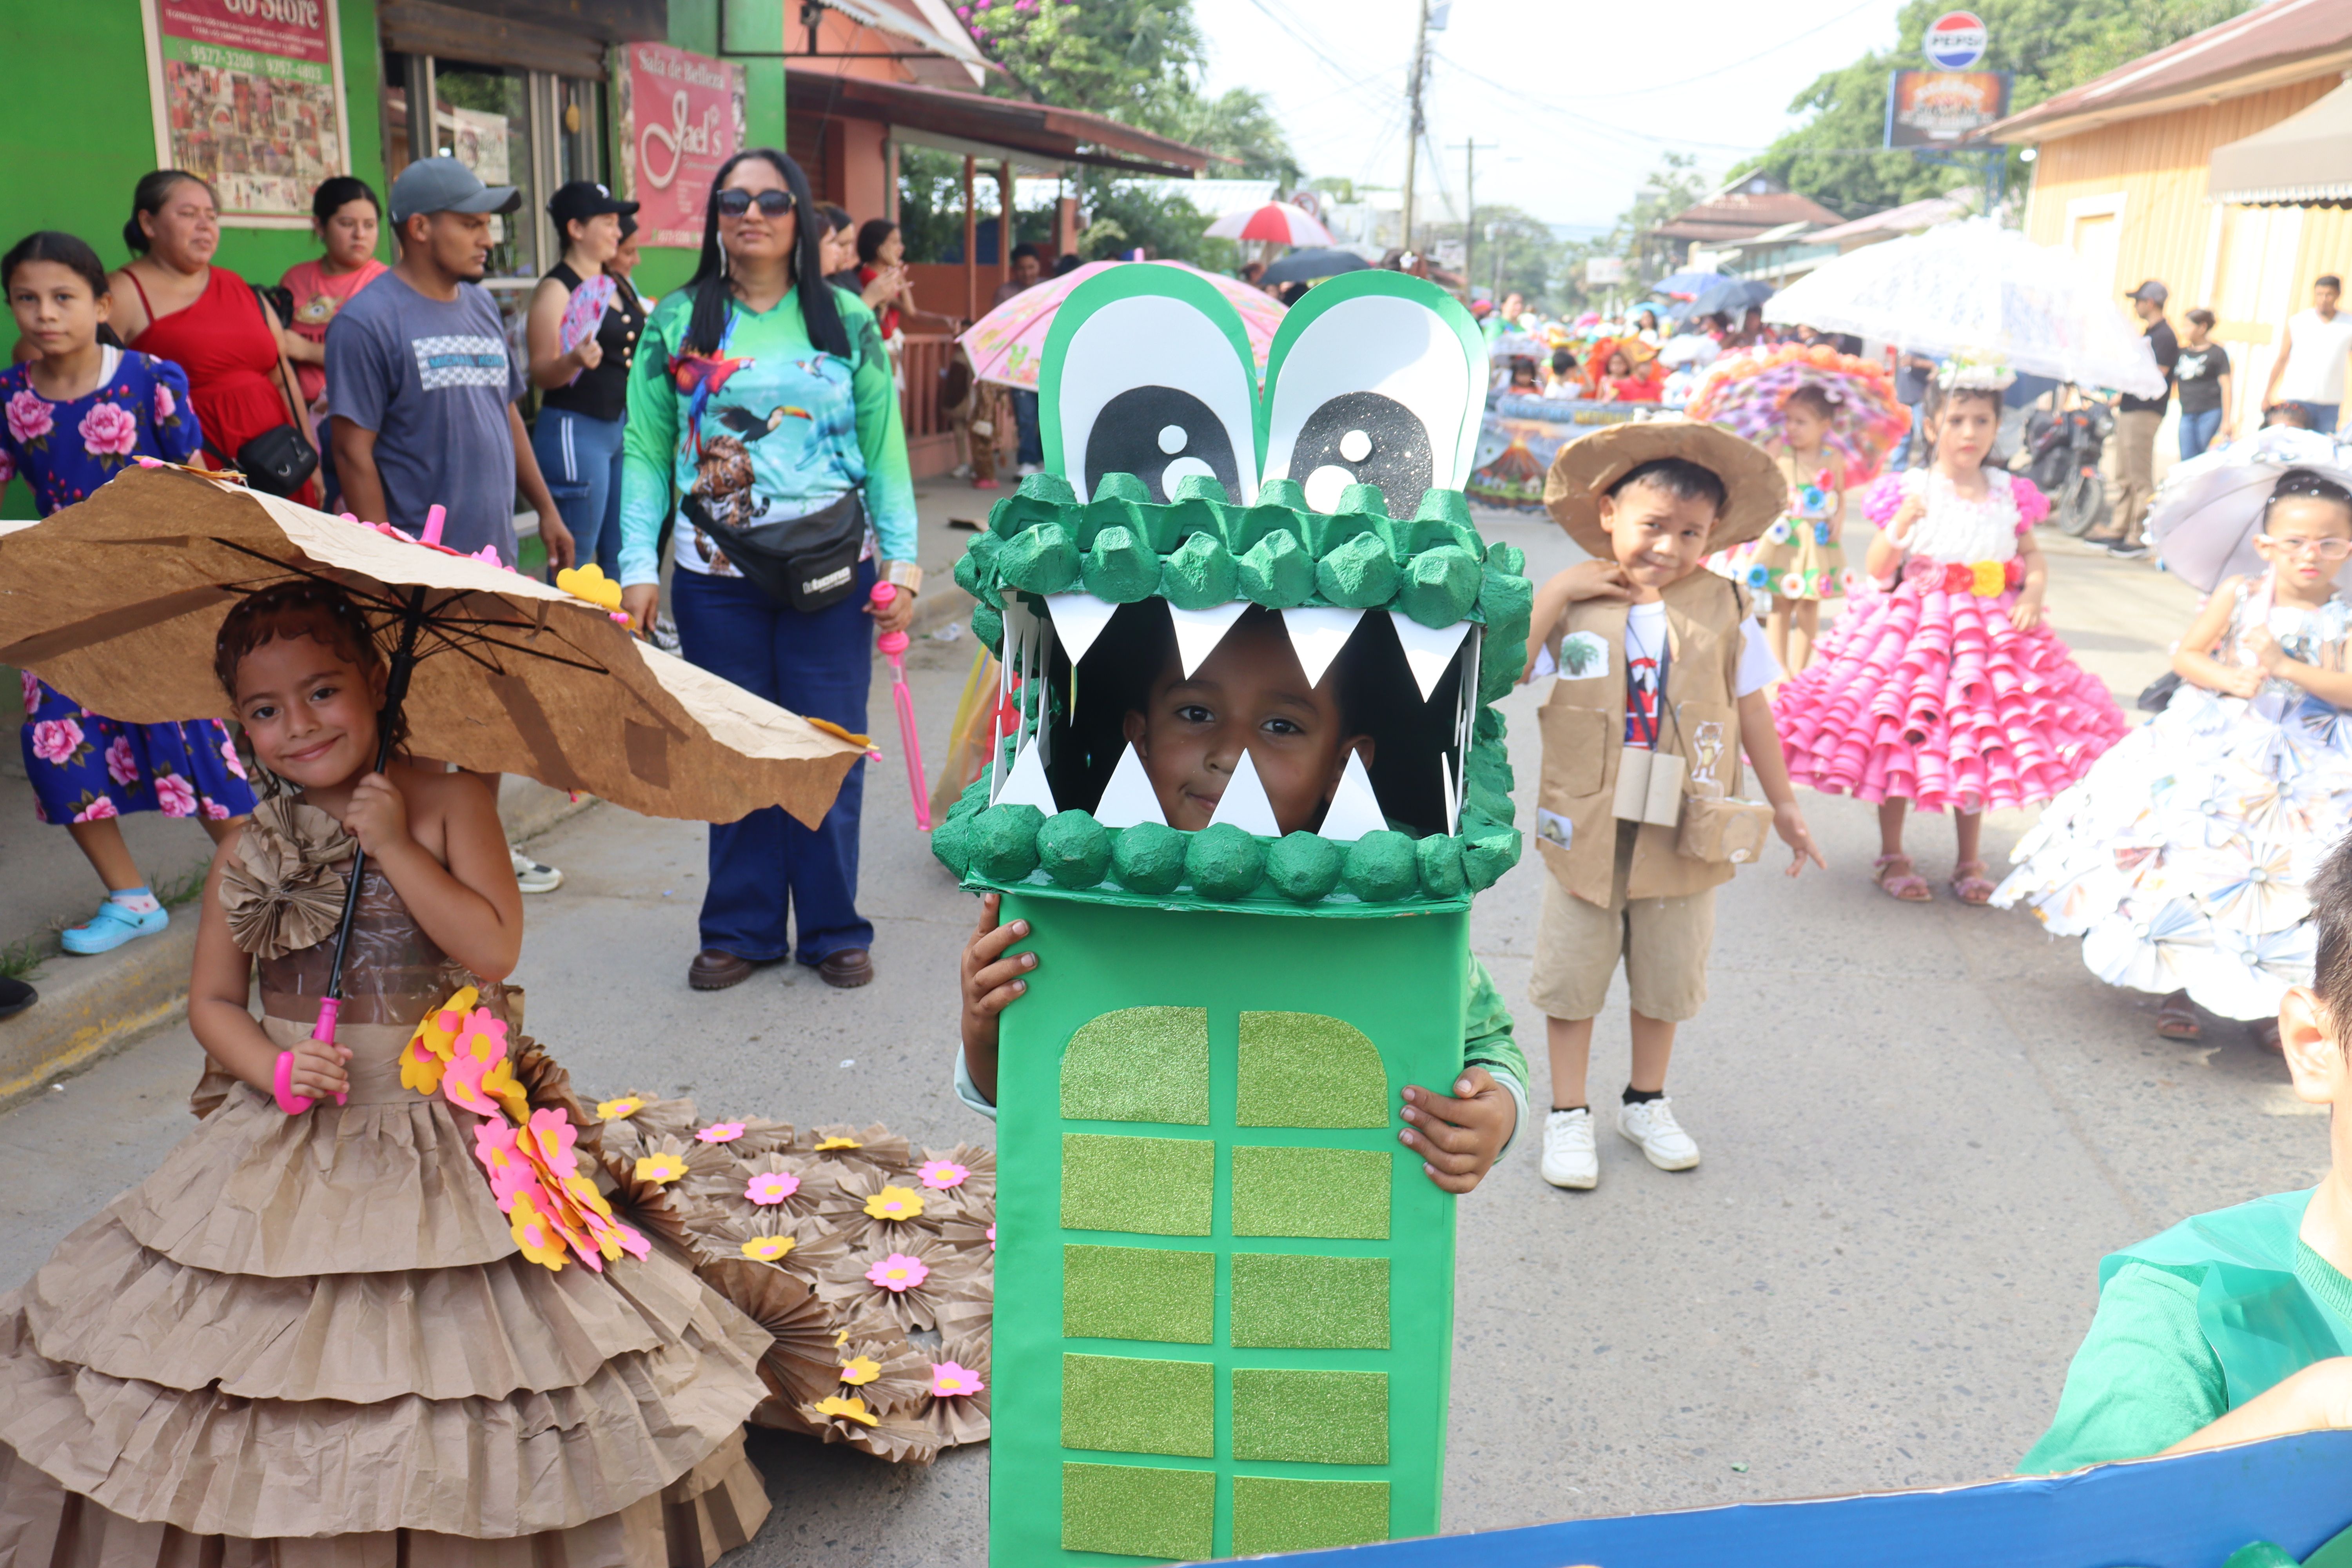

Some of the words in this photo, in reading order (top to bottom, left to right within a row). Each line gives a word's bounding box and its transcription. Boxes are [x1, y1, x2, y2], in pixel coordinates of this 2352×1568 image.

[1932, 33, 1983, 46] PEPSI
[639, 48, 665, 76] Sala
[667, 55, 681, 80] de
[684, 60, 724, 91] Belleza
[640, 89, 723, 189] Jael's
